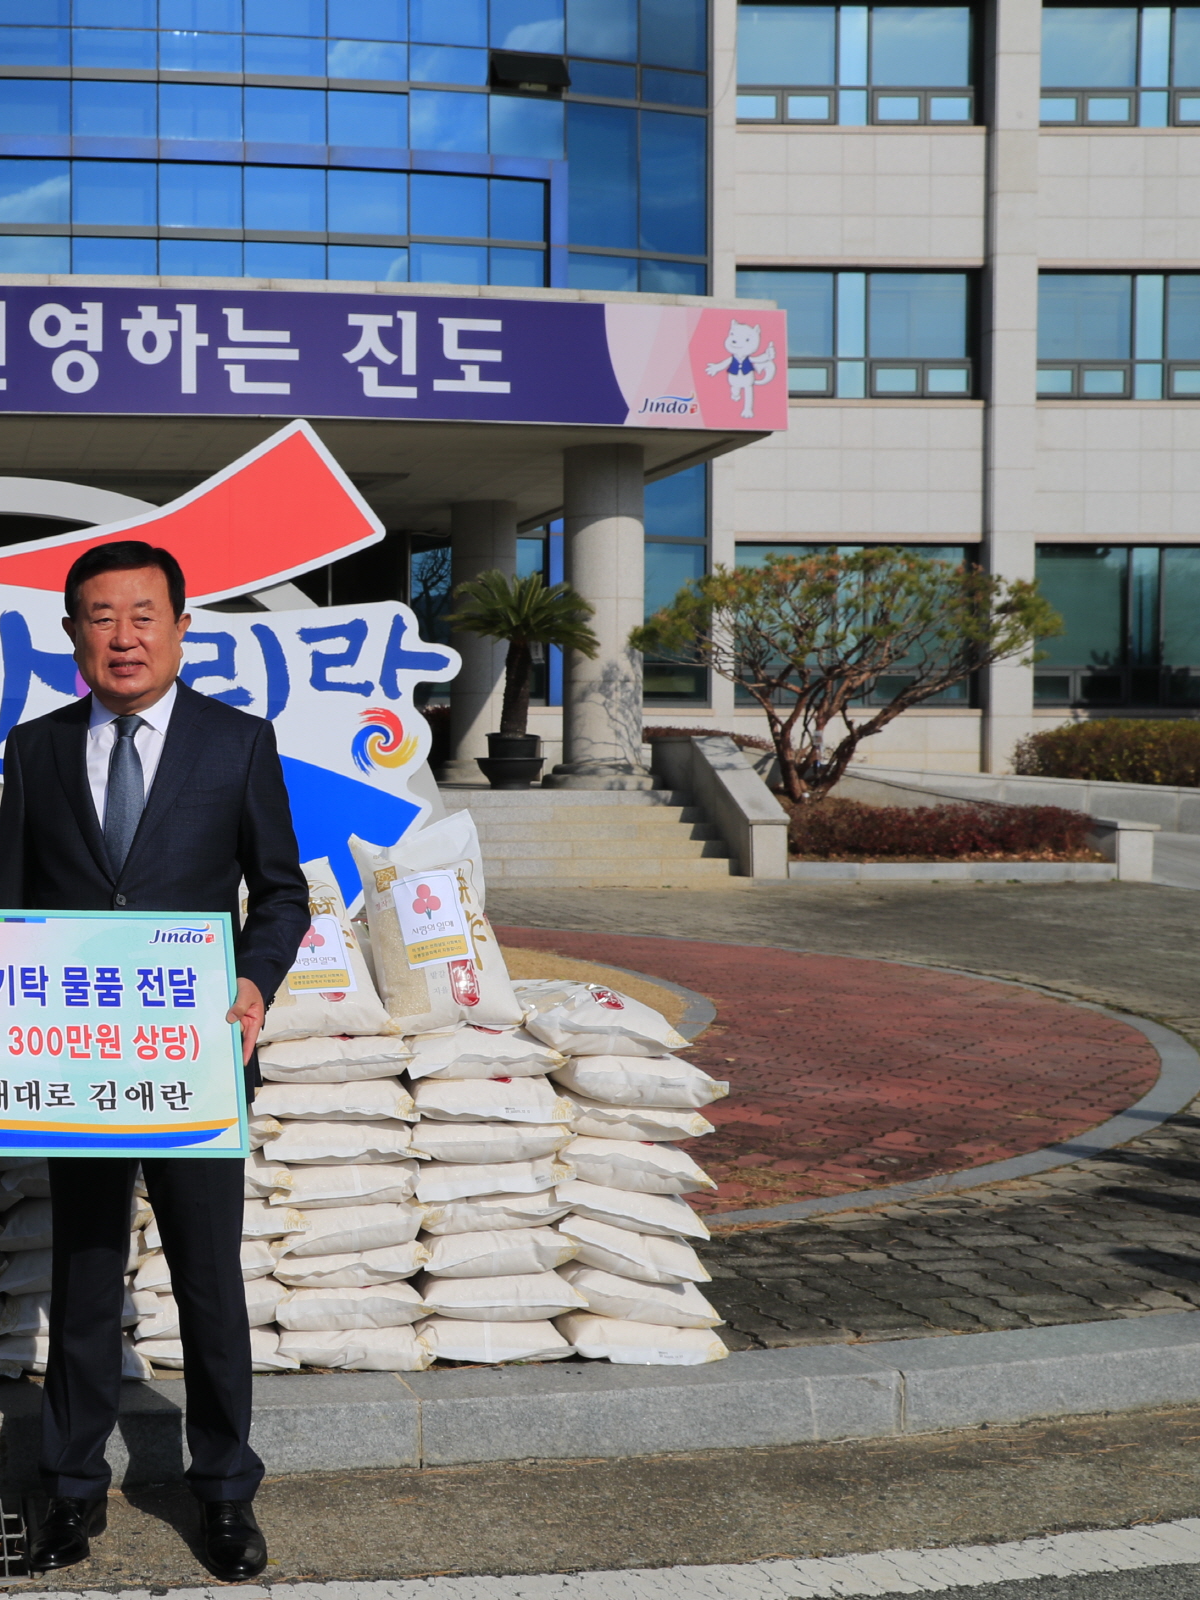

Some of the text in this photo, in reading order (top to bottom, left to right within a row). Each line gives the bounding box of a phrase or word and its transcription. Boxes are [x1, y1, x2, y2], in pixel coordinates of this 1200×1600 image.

[342, 310, 511, 399] 진도
[638, 398, 688, 414] Jindo
[149, 929, 204, 944] Jindo
[61, 967, 124, 1007] 물품
[137, 967, 197, 1008] 전달
[9, 1024, 122, 1060] 300만원
[133, 1025, 200, 1061] 상당)
[90, 1081, 193, 1112] 김애란
